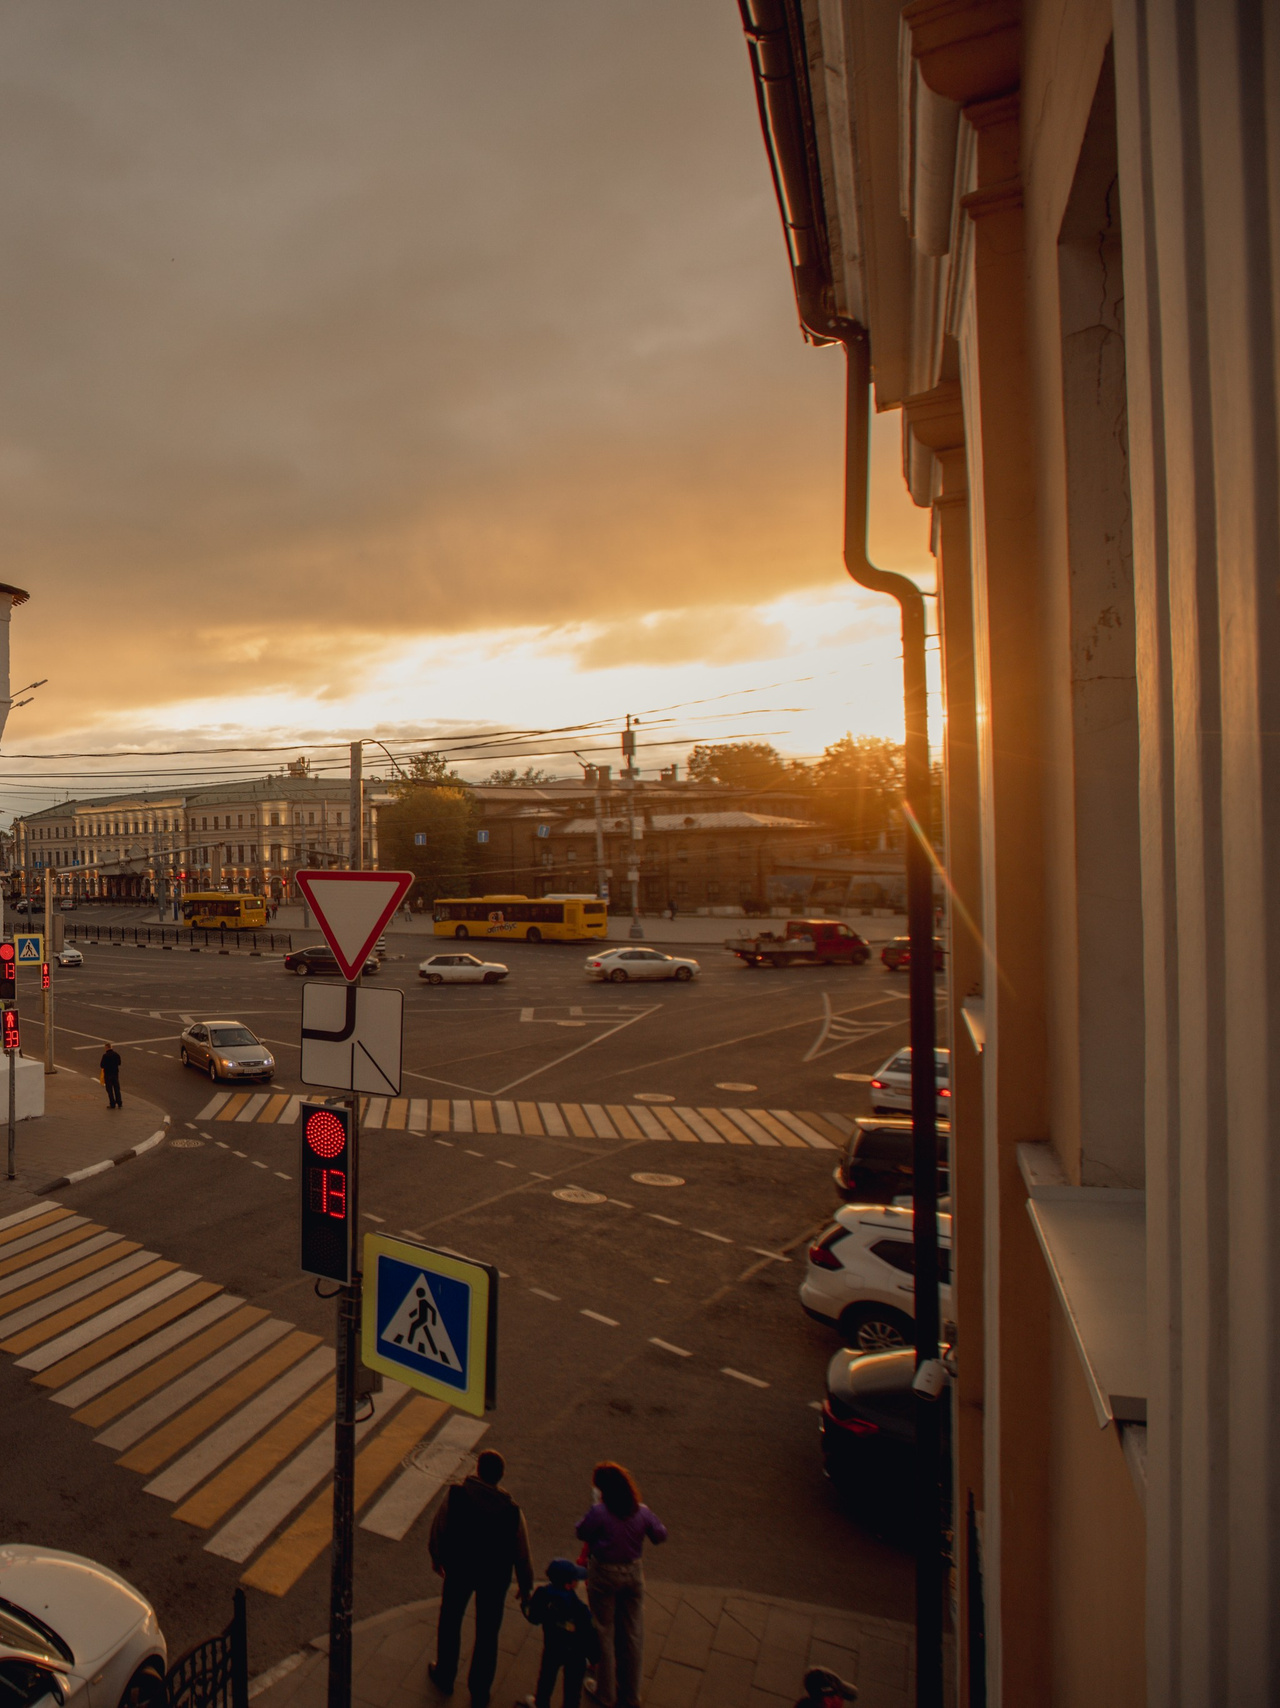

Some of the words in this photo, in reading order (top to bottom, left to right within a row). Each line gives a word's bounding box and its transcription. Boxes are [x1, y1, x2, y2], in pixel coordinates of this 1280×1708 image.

[487, 921, 517, 933] автобус
[5, 962, 15, 980] 13
[5, 1030, 19, 1048] 39
[322, 1169, 346, 1219] 13
